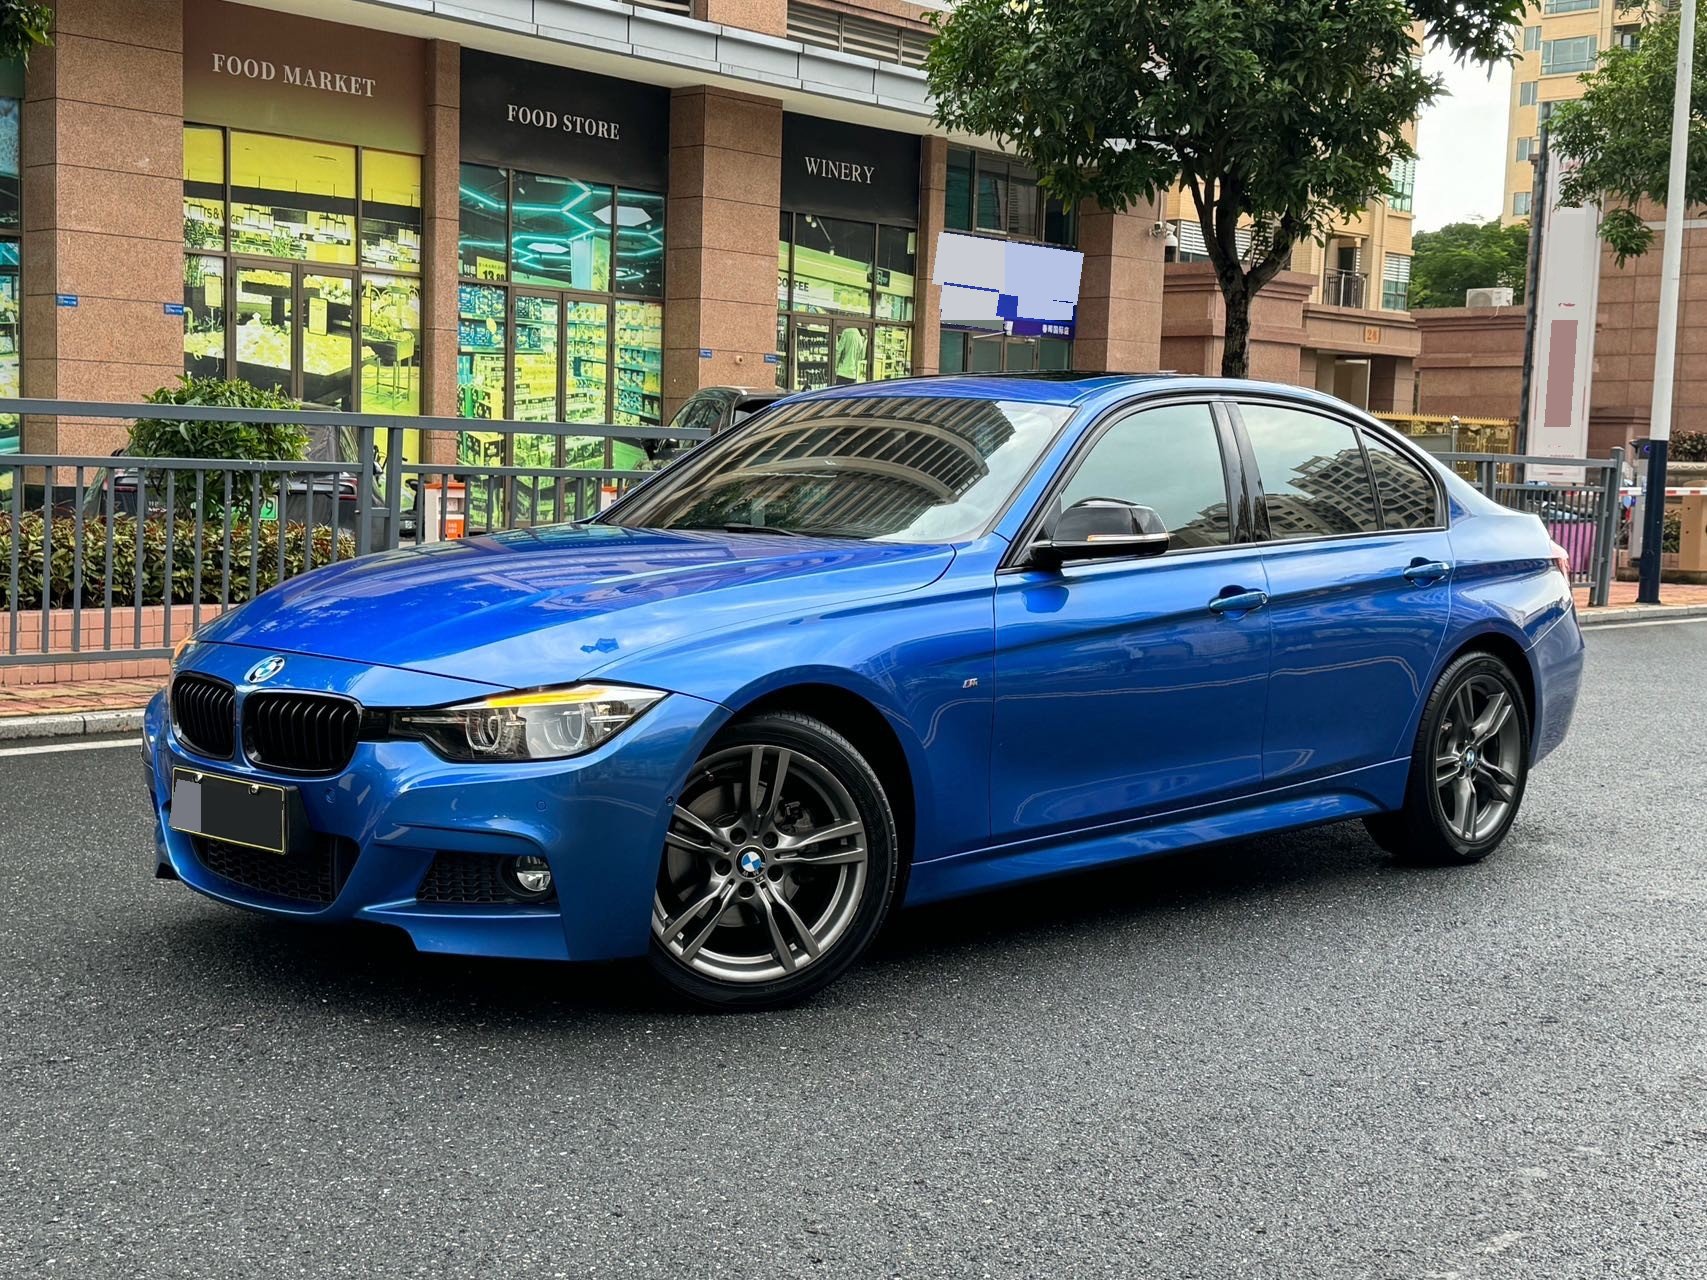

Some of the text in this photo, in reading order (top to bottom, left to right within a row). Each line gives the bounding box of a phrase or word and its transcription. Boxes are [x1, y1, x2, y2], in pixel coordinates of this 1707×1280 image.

[212, 53, 377, 97] FOOD MARKET
[507, 103, 620, 140] FOOD STORE
[804, 157, 875, 184] WINERY
[777, 276, 809, 292] COFEE
